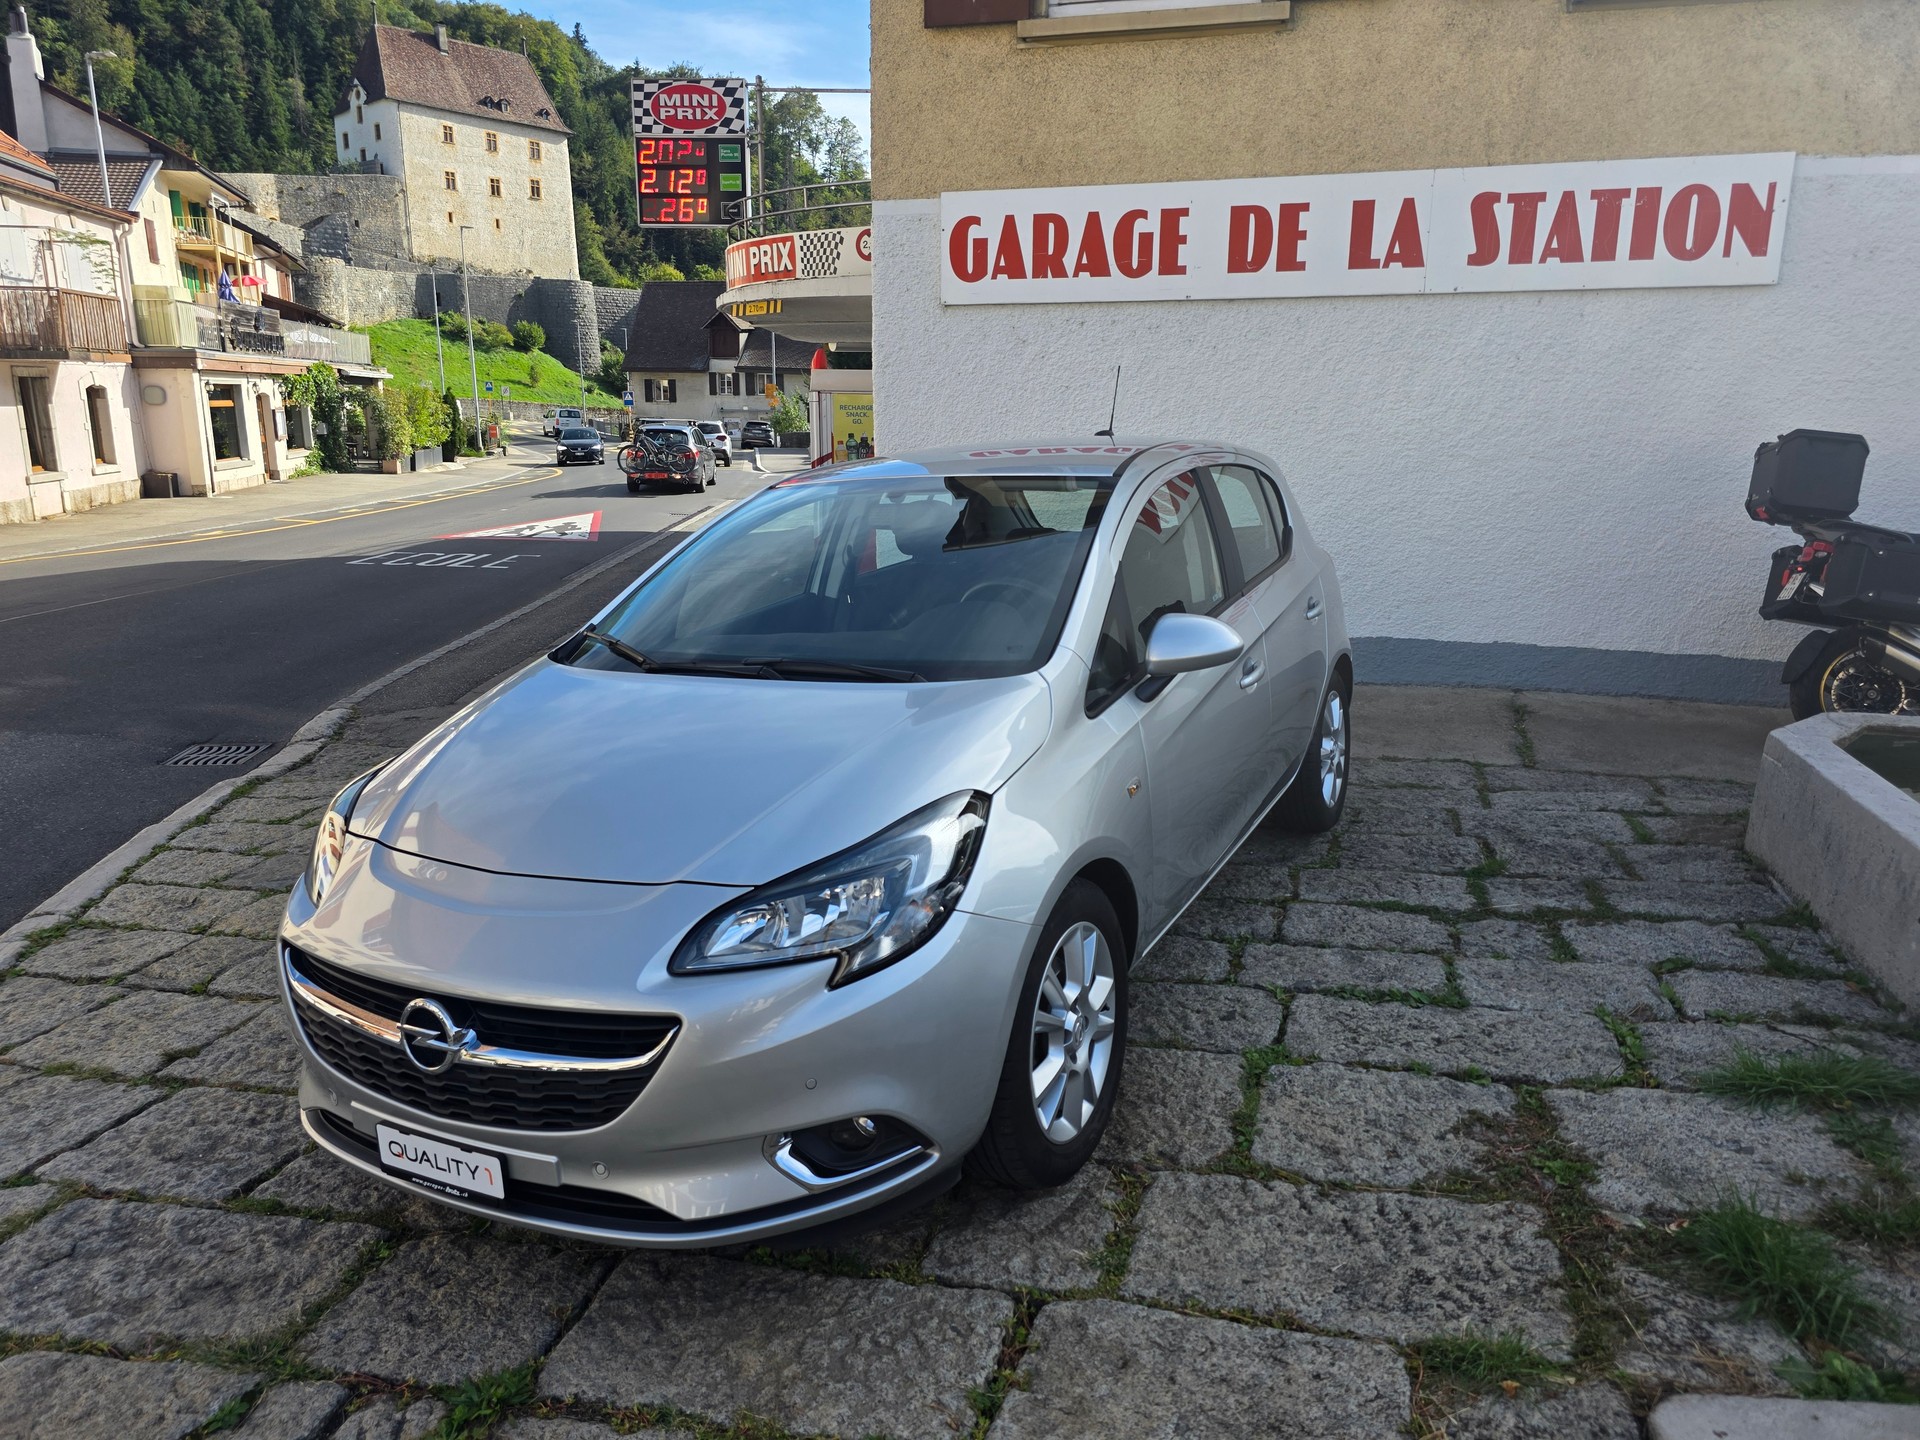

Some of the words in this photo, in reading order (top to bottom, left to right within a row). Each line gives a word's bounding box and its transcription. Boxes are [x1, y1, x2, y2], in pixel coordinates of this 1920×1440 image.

[659, 93, 718, 107] MINI
[659, 107, 720, 120] PRIX
[949, 206, 1190, 284] GARAGE
[1227, 201, 1310, 275] DE
[1348, 197, 1426, 271] LA
[1467, 180, 1777, 268] STATION
[728, 248, 747, 279] MINI
[749, 240, 793, 275] PRIX
[345, 551, 541, 569] ECOLE
[388, 1140, 480, 1180] QUALITY
